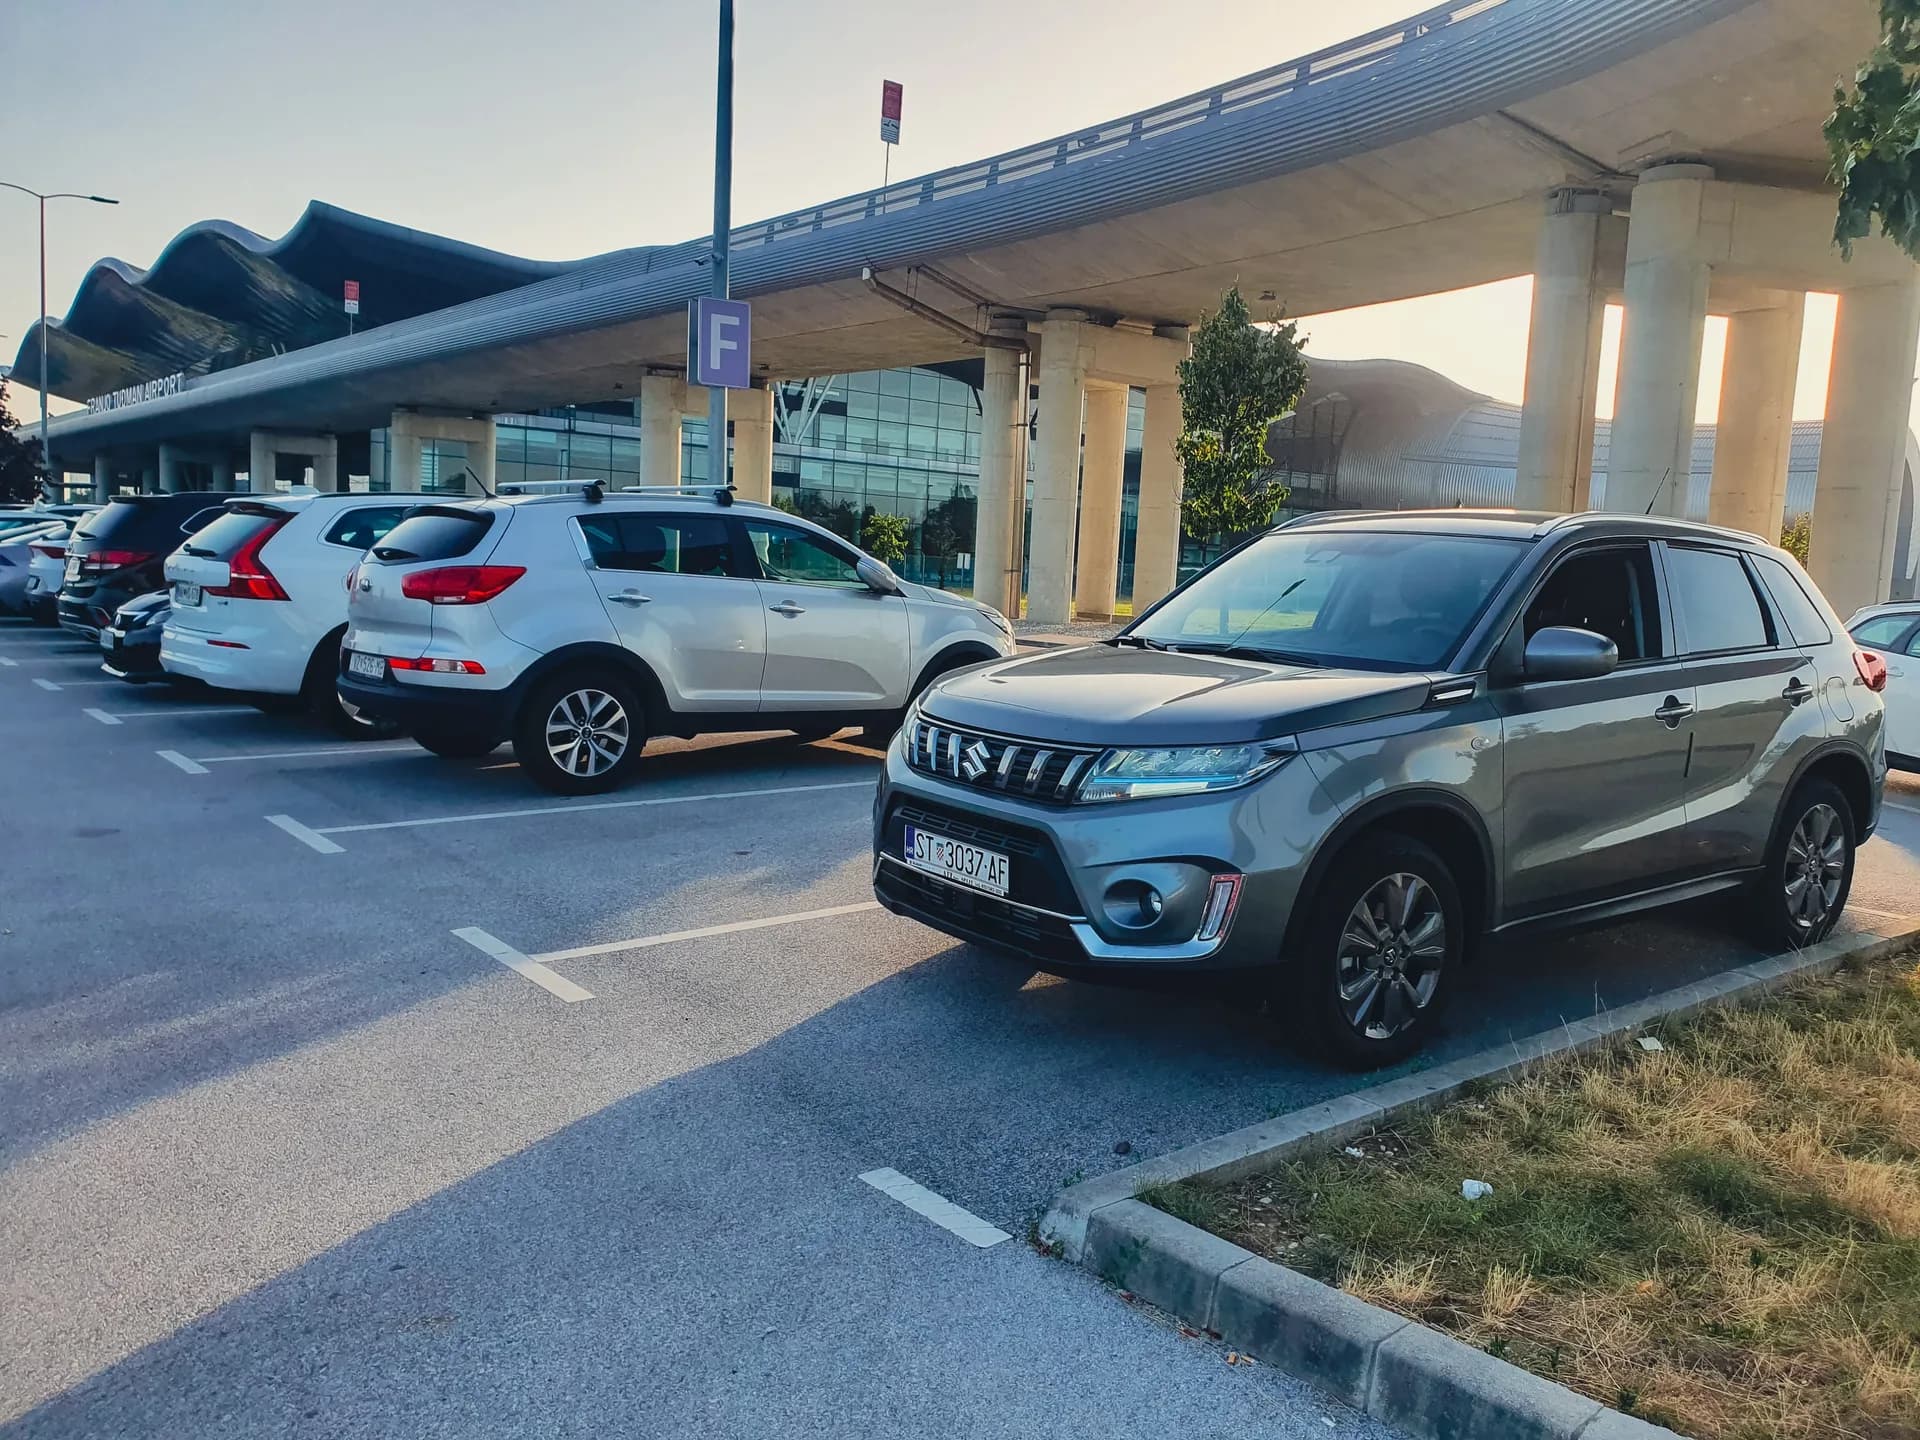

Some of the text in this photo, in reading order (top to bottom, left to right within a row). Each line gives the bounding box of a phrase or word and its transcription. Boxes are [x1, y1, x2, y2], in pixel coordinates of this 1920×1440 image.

[711, 313, 740, 370] F
[87, 394, 111, 415] FRANJO
[145, 372, 184, 401] AIRPORT
[916, 833, 934, 861] ST
